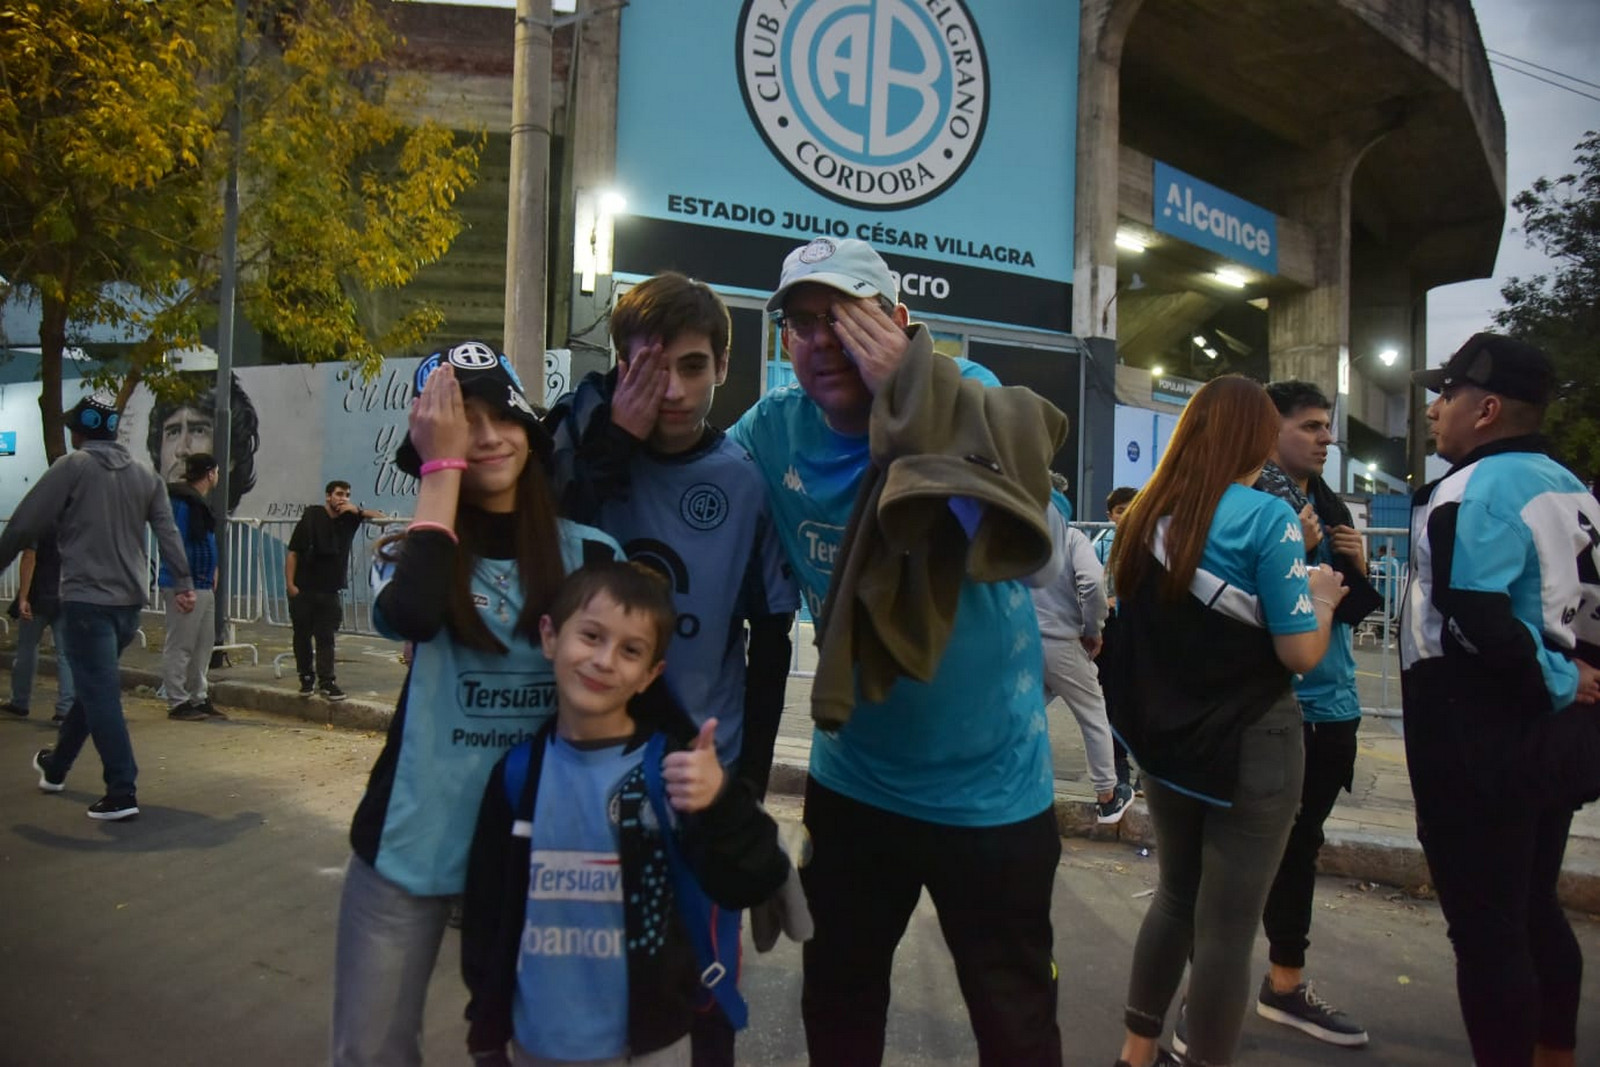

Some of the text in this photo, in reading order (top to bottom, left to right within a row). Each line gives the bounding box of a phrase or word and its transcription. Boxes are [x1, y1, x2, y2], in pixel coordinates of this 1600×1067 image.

[753, 13, 780, 102] CLUB
[926, 0, 976, 140] ELGRANO
[796, 140, 935, 195] CORDOBA
[668, 194, 775, 226] ESTADIO
[782, 211, 849, 238] JULIO
[856, 222, 928, 251] CÉSAR
[934, 235, 1036, 268] VILLAGRA
[1163, 182, 1270, 256] Alcance
[463, 681, 557, 709] Tersuav
[531, 863, 621, 892] Tersuav
